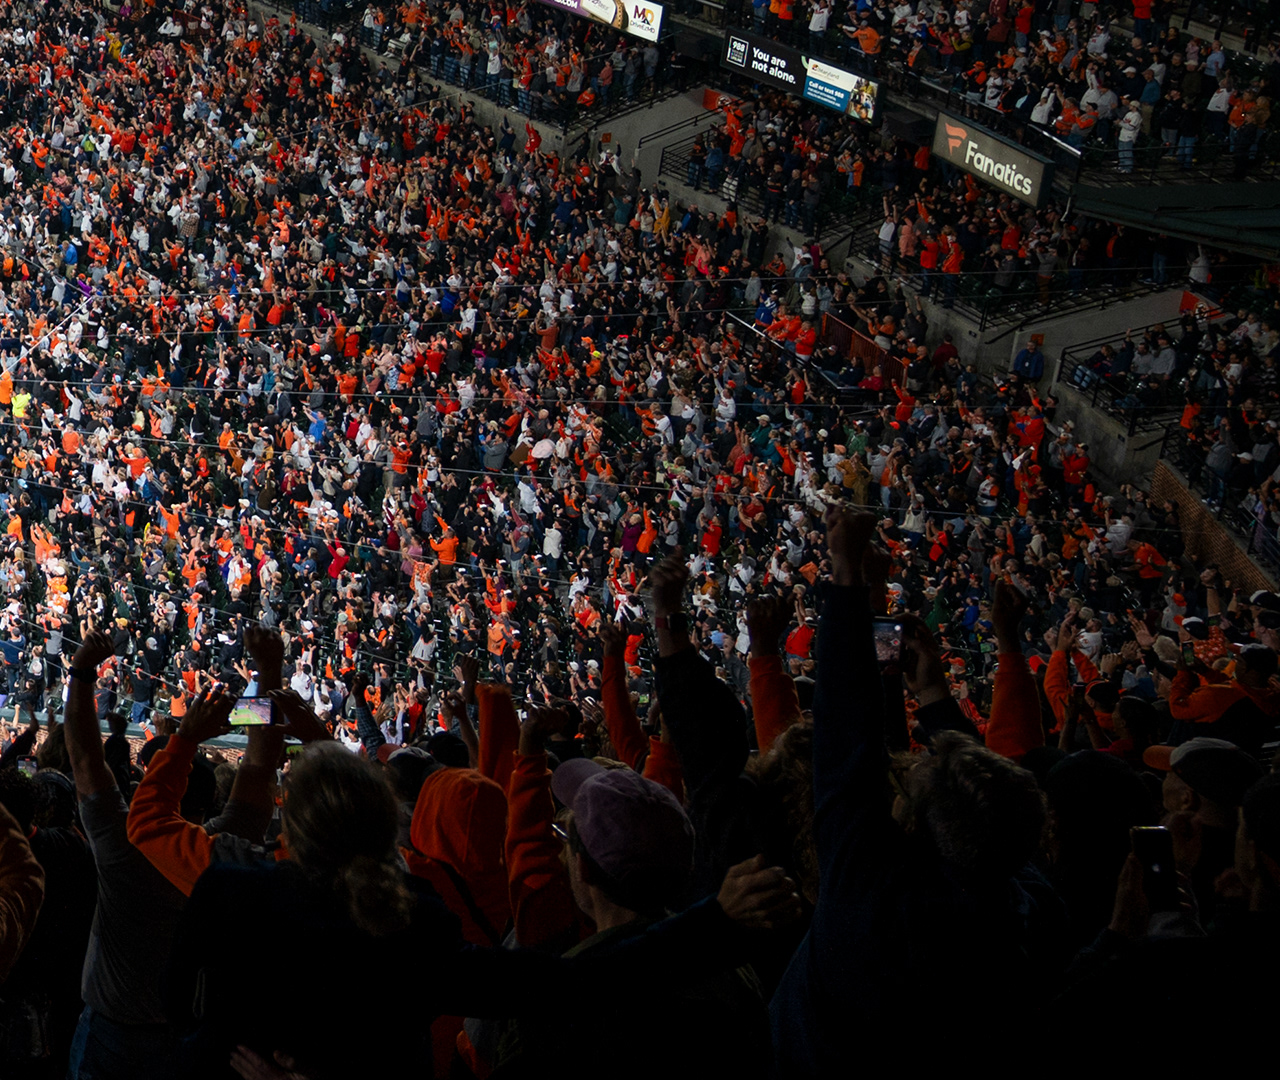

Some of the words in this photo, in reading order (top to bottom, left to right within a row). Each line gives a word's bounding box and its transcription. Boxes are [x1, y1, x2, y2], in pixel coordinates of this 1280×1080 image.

[732, 41, 745, 52] 988
[753, 47, 770, 63] You
[771, 55, 786, 68] are
[752, 60, 768, 73] not
[769, 65, 796, 85] alone.
[965, 140, 1033, 195] Fanatics
